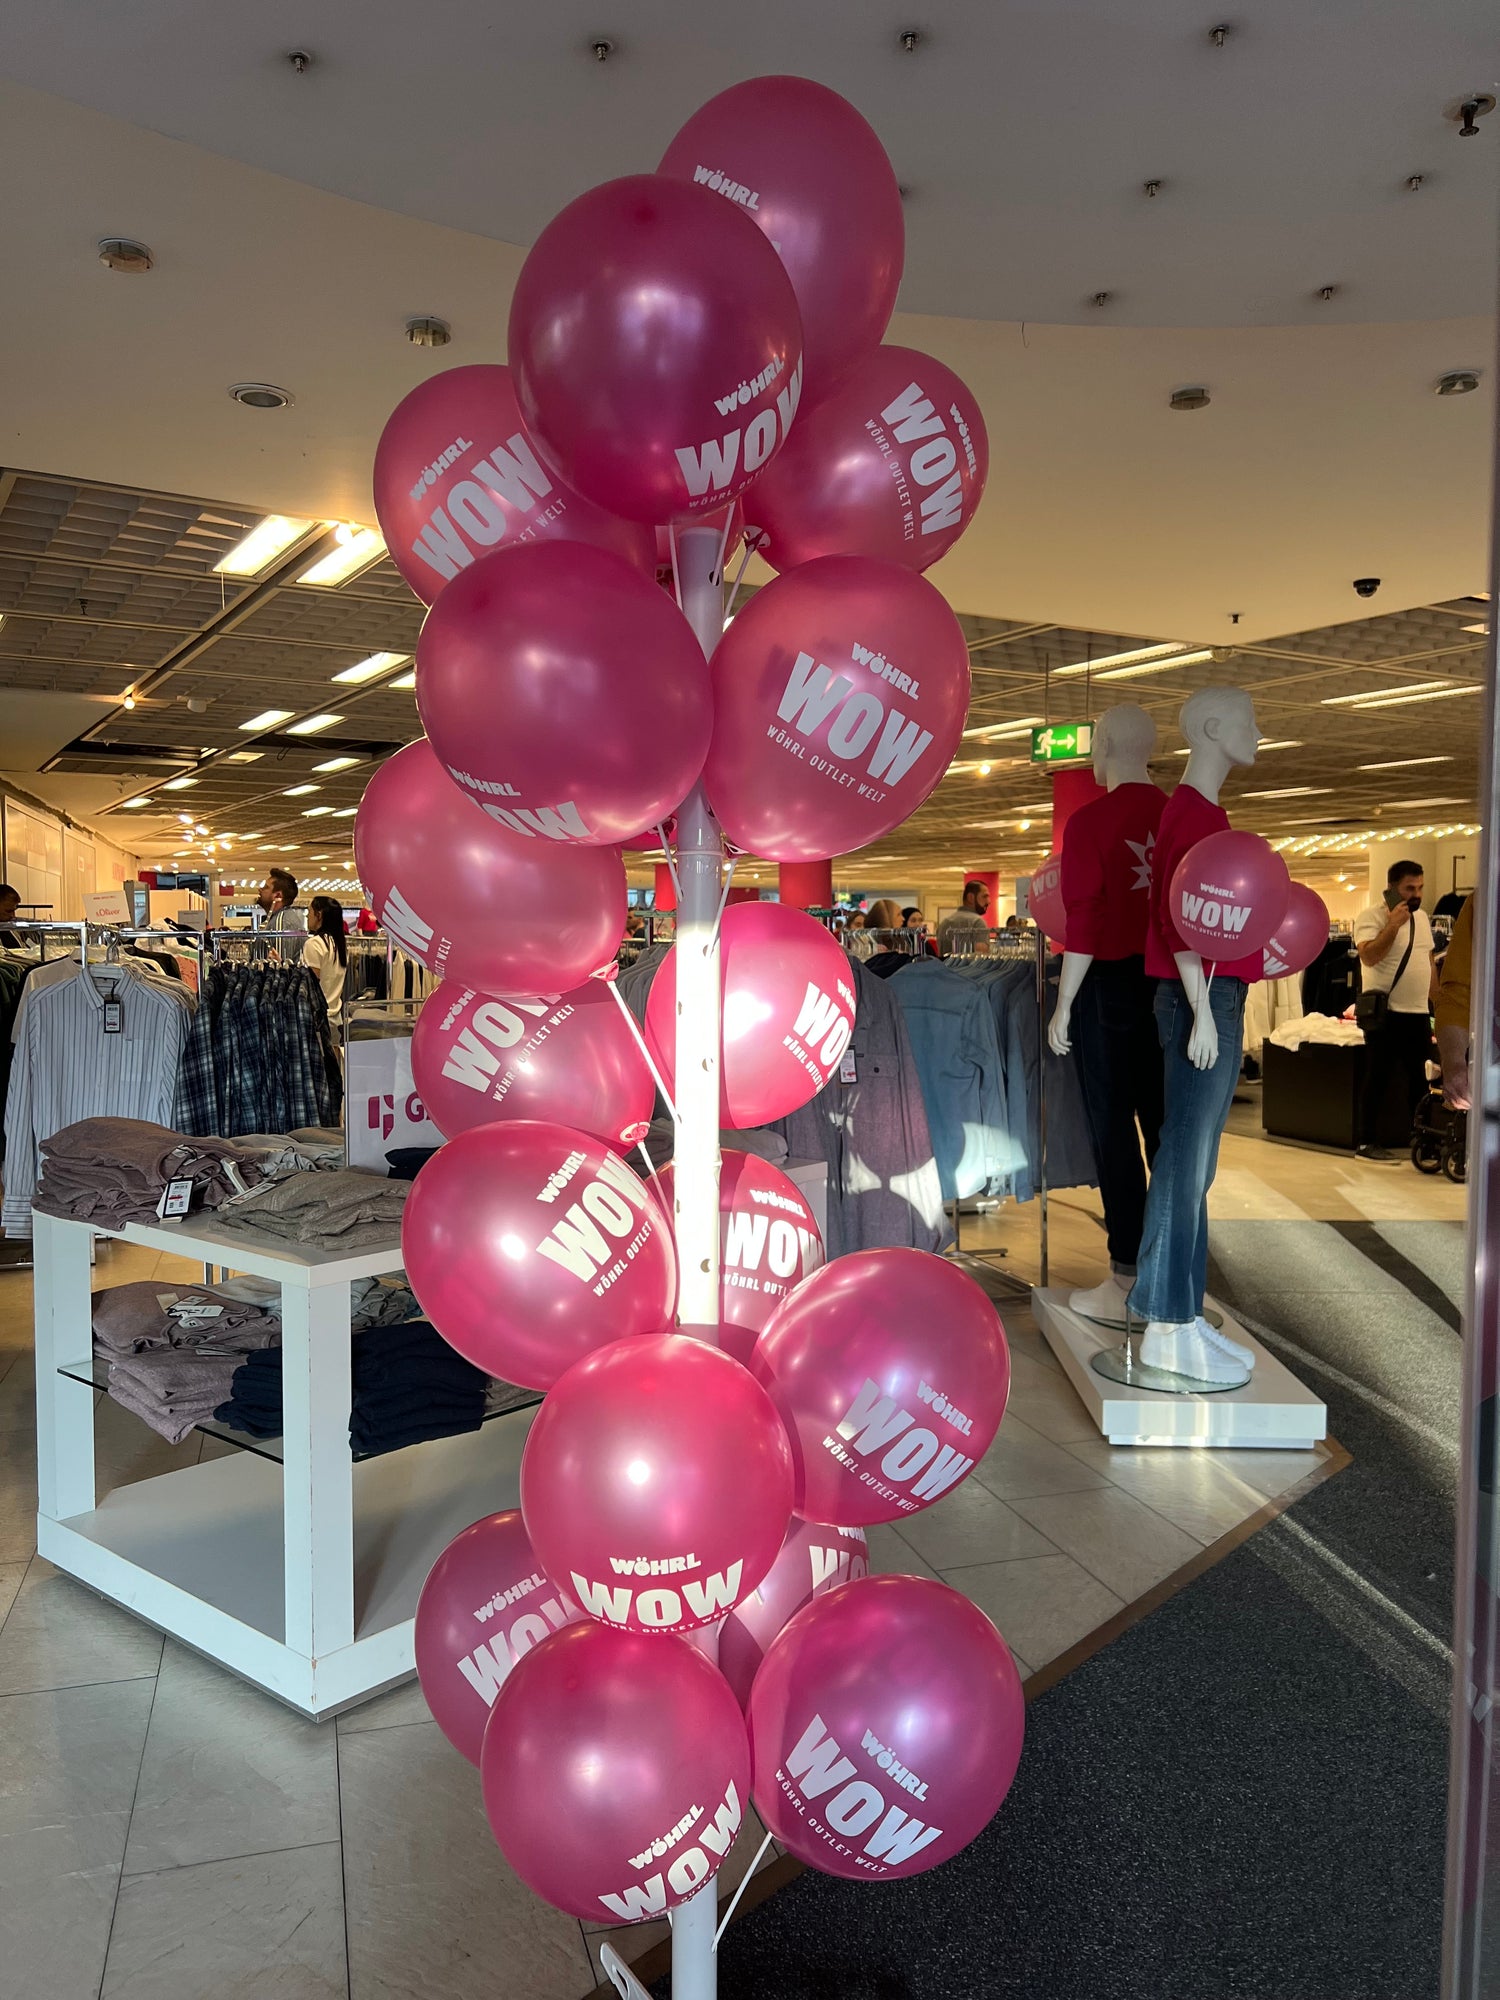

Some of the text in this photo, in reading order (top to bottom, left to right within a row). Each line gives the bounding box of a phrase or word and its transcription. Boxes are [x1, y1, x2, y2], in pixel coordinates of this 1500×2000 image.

[693, 164, 760, 211] WÖHRL
[714, 354, 785, 416] WÖHRL
[409, 437, 474, 501] WÖHRL
[880, 382, 963, 535] WOW
[950, 402, 977, 480] WÖHRL
[411, 432, 553, 582] WOW
[535, 498, 567, 528] WELT
[864, 419, 915, 541] WÖHRL OUTLET WELT
[851, 642, 920, 700] WÖHRL
[777, 651, 934, 787] WOW
[766, 724, 887, 803] WÖHRL OUTLET WELT
[463, 791, 592, 840] OW
[1182, 891, 1252, 933] WOW
[1200, 882, 1235, 898] WÖHRL
[439, 988, 477, 1031] WÖH
[548, 1004, 575, 1026] WELT
[793, 981, 852, 1080] WO
[536, 1150, 587, 1203] WÖHRL
[535, 1149, 648, 1283] WOW
[593, 1221, 653, 1297] WÖHRL OUTLET
[835, 1377, 974, 1501] WOW
[917, 1379, 973, 1436] WÖHRL
[822, 1435, 920, 1511] WÖHRL OUTLET WELT
[570, 1558, 744, 1626] WOW
[609, 1552, 702, 1576] WÖHRL
[473, 1573, 547, 1623] WÖHRL
[642, 1622, 695, 1633] OUTLET
[785, 1713, 943, 1865] WOW
[860, 1728, 929, 1802] WÖHRL
[598, 1778, 741, 1920] WOW
[627, 1804, 704, 1870] WÖHRL
[775, 1769, 887, 1873] WÖHRL OUTLET WELT
